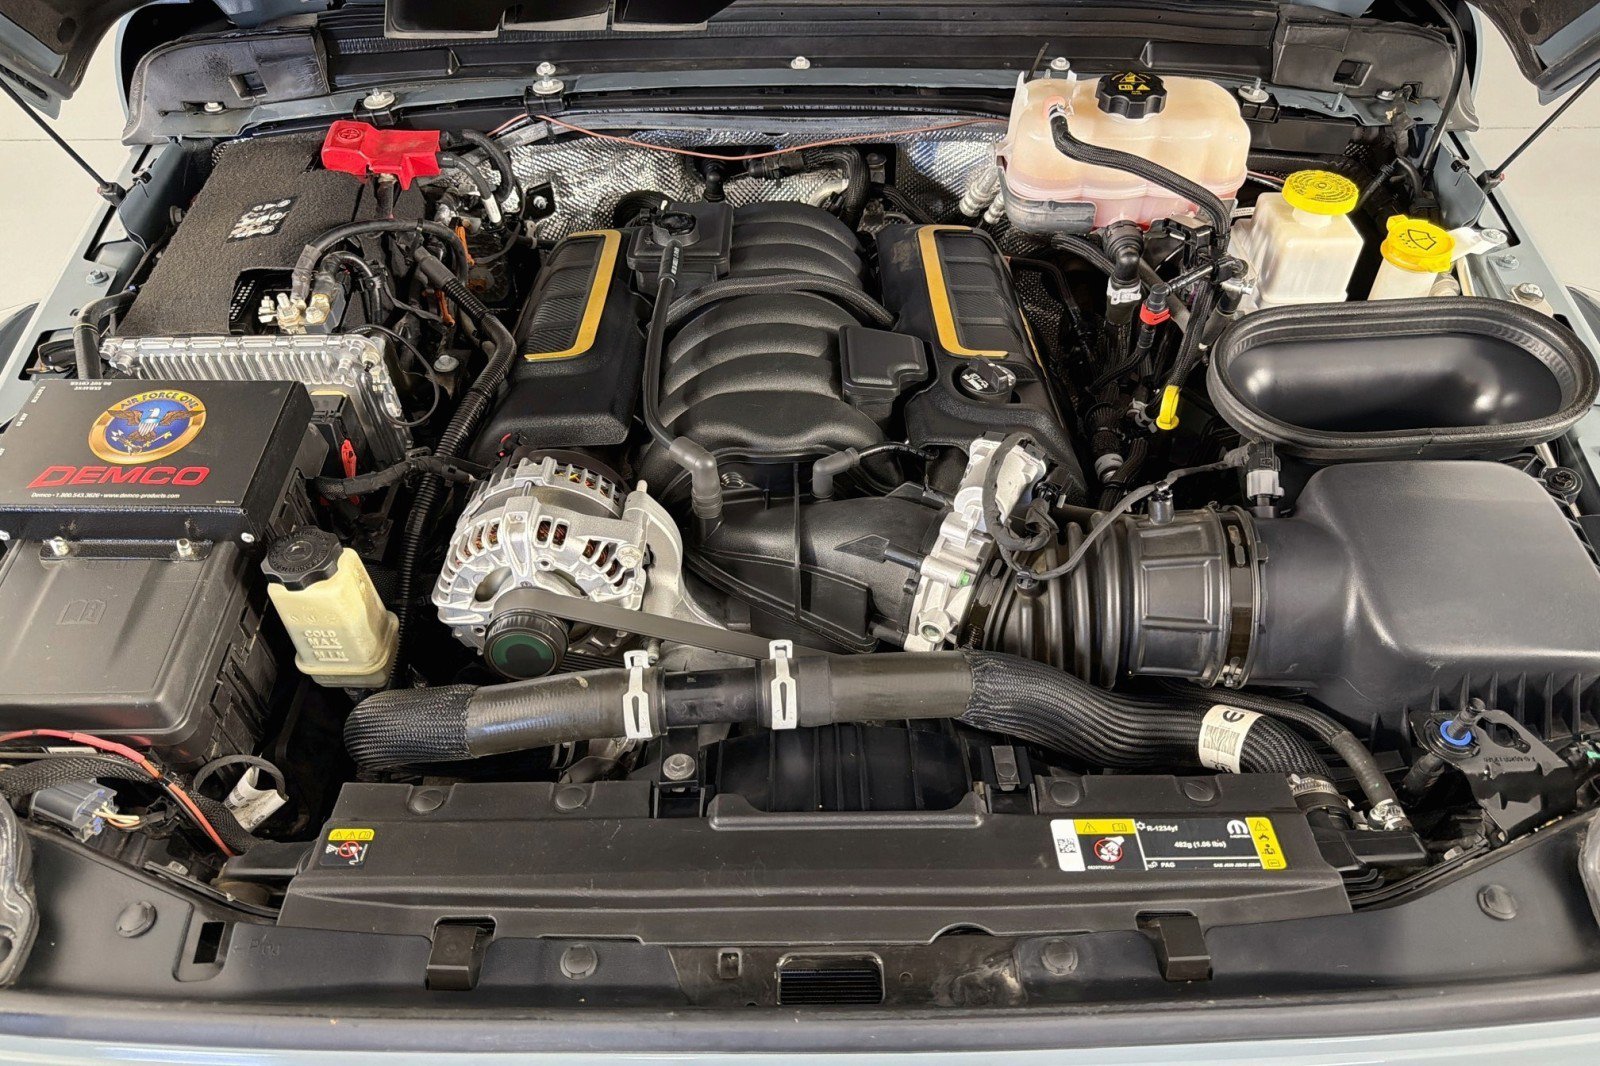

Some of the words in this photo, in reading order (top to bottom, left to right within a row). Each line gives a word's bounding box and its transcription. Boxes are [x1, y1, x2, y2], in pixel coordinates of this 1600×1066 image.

[120, 397, 139, 410] AIR
[142, 391, 179, 402] FORCE
[179, 395, 199, 410] ONE
[26, 465, 211, 489] DEMCO
[304, 630, 337, 638] COLD
[307, 638, 341, 646] MAX
[313, 651, 346, 659] MIN
